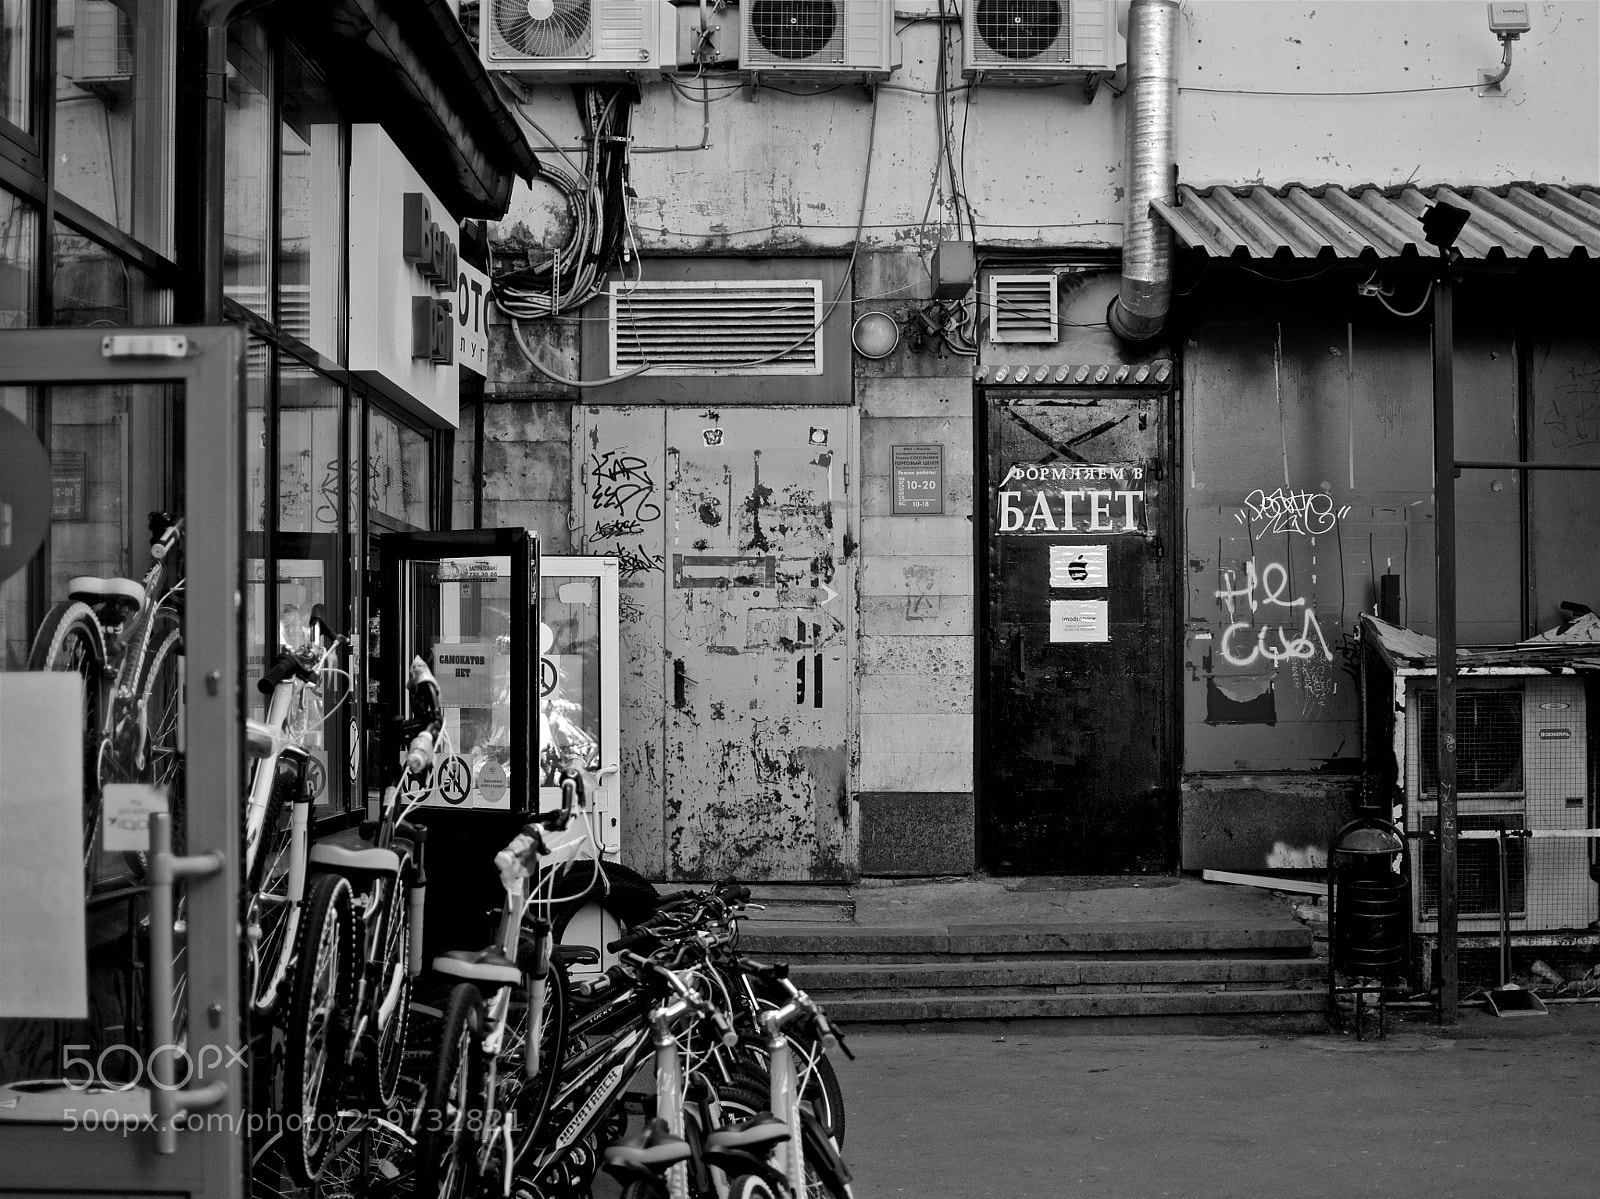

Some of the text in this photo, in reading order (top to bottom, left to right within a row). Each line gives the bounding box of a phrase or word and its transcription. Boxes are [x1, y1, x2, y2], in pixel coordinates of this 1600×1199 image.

[1134, 467, 1143, 480] В
[906, 480, 936, 490] 10-20
[999, 490, 1144, 531] БАГЕТ
[439, 654, 485, 665] САМОКАТОВ
[455, 668, 471, 678] НЕТ
[590, 1007, 613, 1023] LUCKY
[559, 1070, 618, 1145] NOVATRACK
